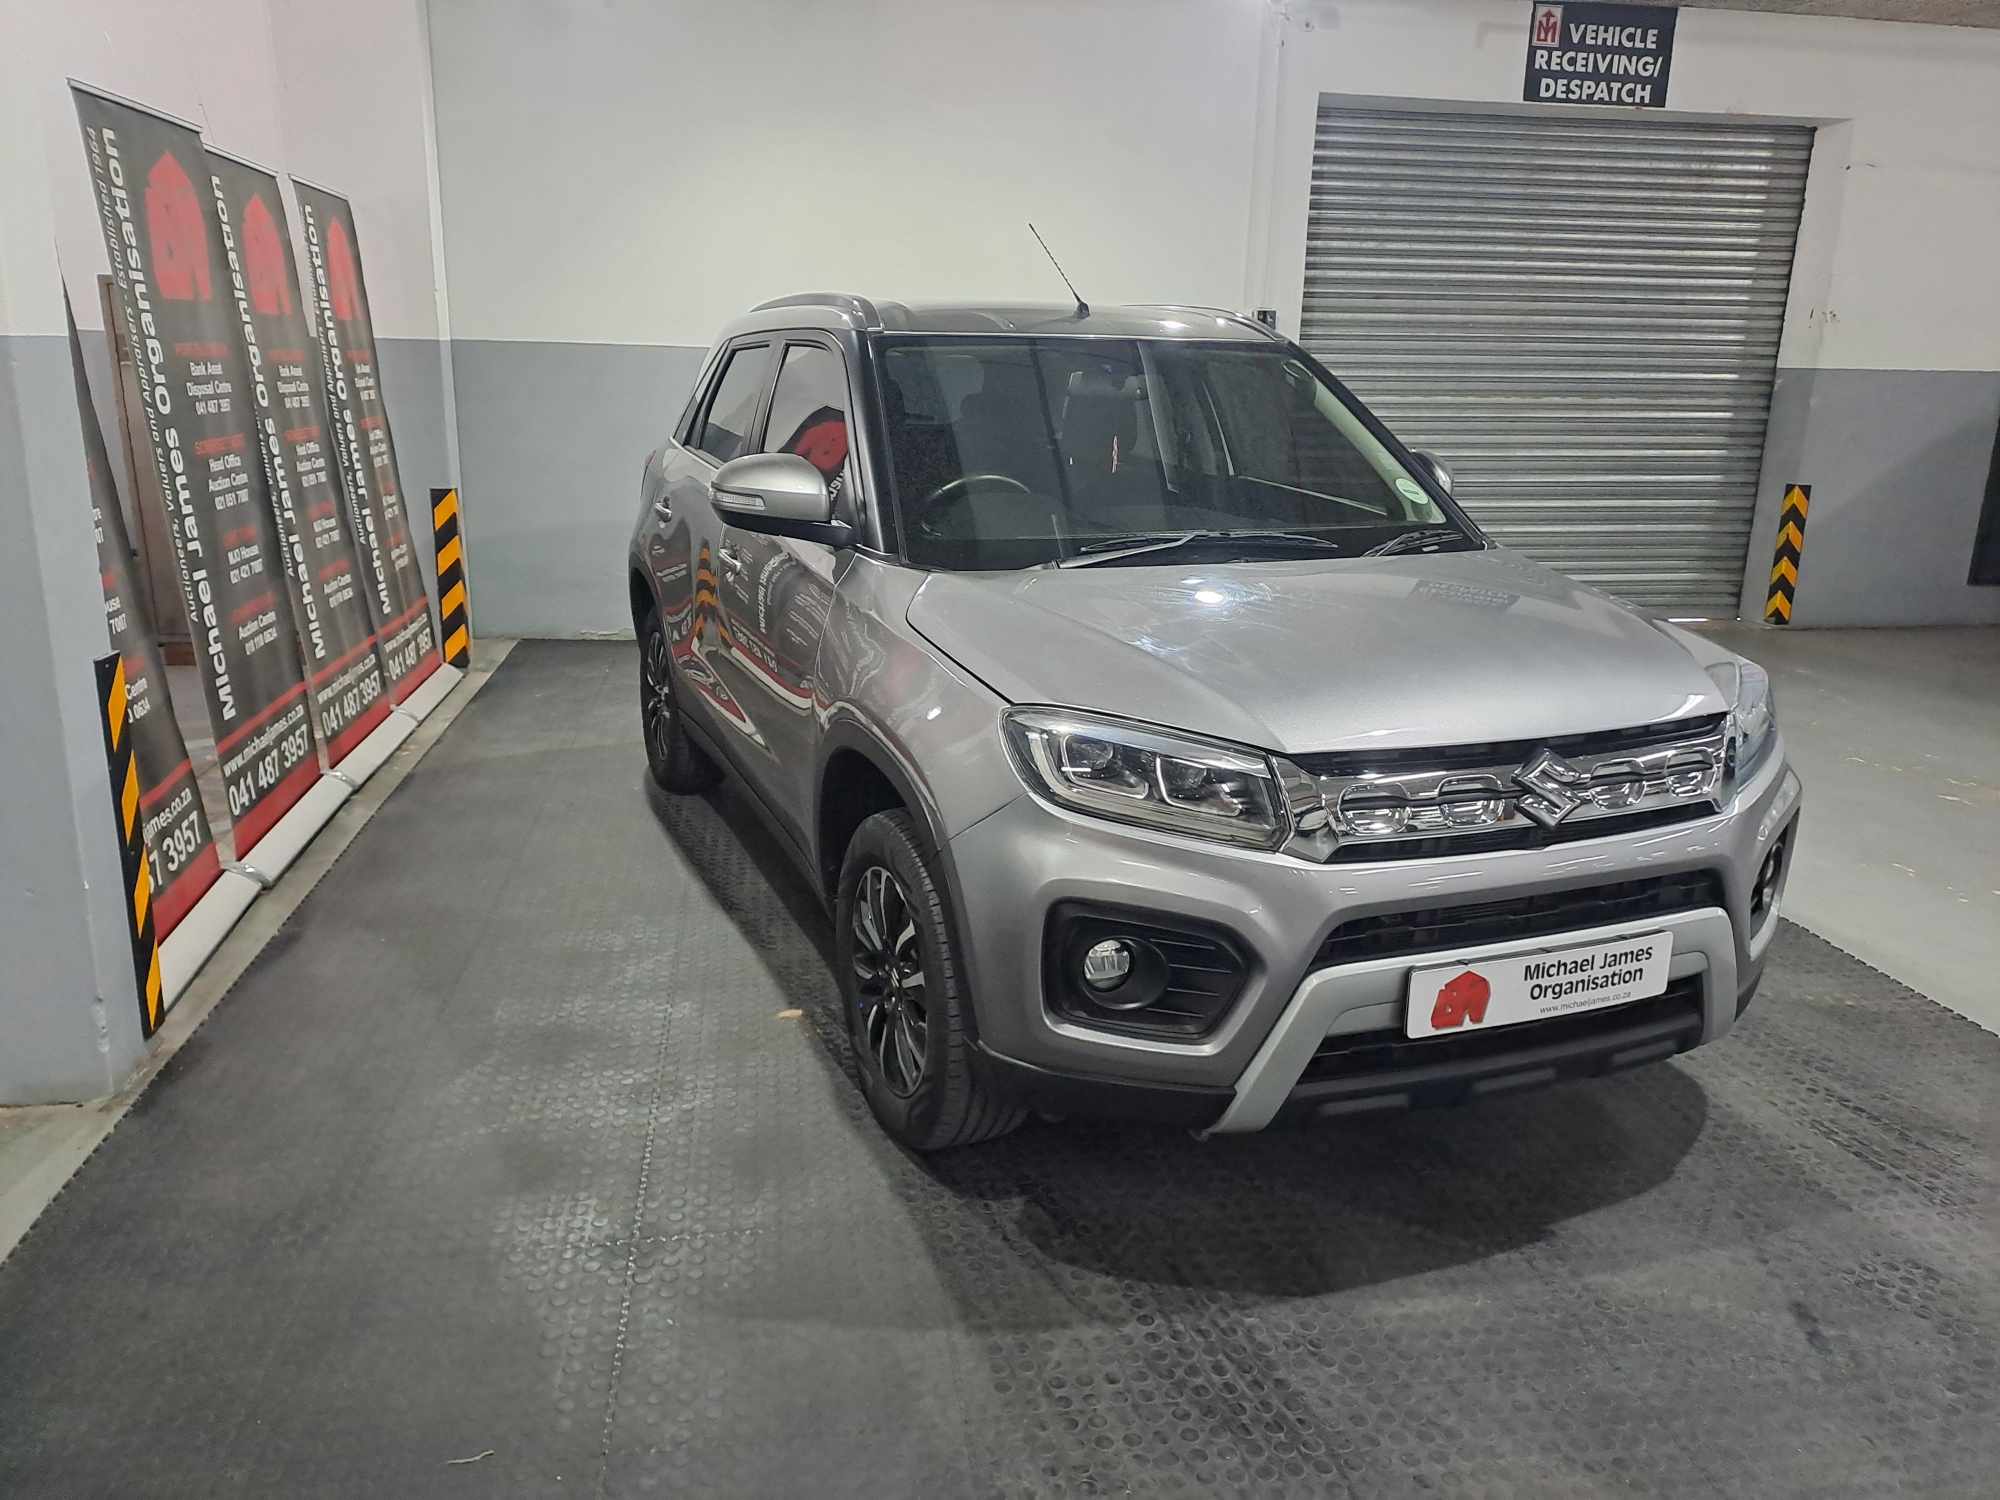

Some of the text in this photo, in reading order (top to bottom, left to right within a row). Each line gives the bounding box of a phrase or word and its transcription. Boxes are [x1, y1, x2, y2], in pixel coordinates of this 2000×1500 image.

[1534, 49, 1663, 78] RECEIVING/
[1569, 23, 1659, 49] VEHICLE
[1539, 77, 1652, 104] DESPATCH
[96, 179, 128, 289] Established
[211, 176, 269, 407] Organisation
[304, 205, 347, 400] Organisation
[125, 305, 152, 403] Appraisers
[102, 127, 237, 721] Michael James Organisation
[145, 406, 160, 442] and
[343, 409, 368, 500] James
[156, 447, 175, 511] Valuers
[264, 418, 296, 525] James
[171, 518, 199, 623] Auctioneers,
[288, 533, 326, 659] Michael
[361, 508, 391, 615] Michael
[389, 651, 406, 680] 041
[322, 670, 381, 737] 041 487 3957
[222, 703, 304, 777] www.michaeljames.co.za
[228, 723, 308, 816] 041 487 3957
[142, 786, 192, 848] james.co.za
[162, 810, 202, 872] 3957
[1523, 946, 1653, 982] Michael James
[1529, 966, 1644, 1000] Organisation
[1539, 991, 1632, 1015] www.michaeljames.co.za
